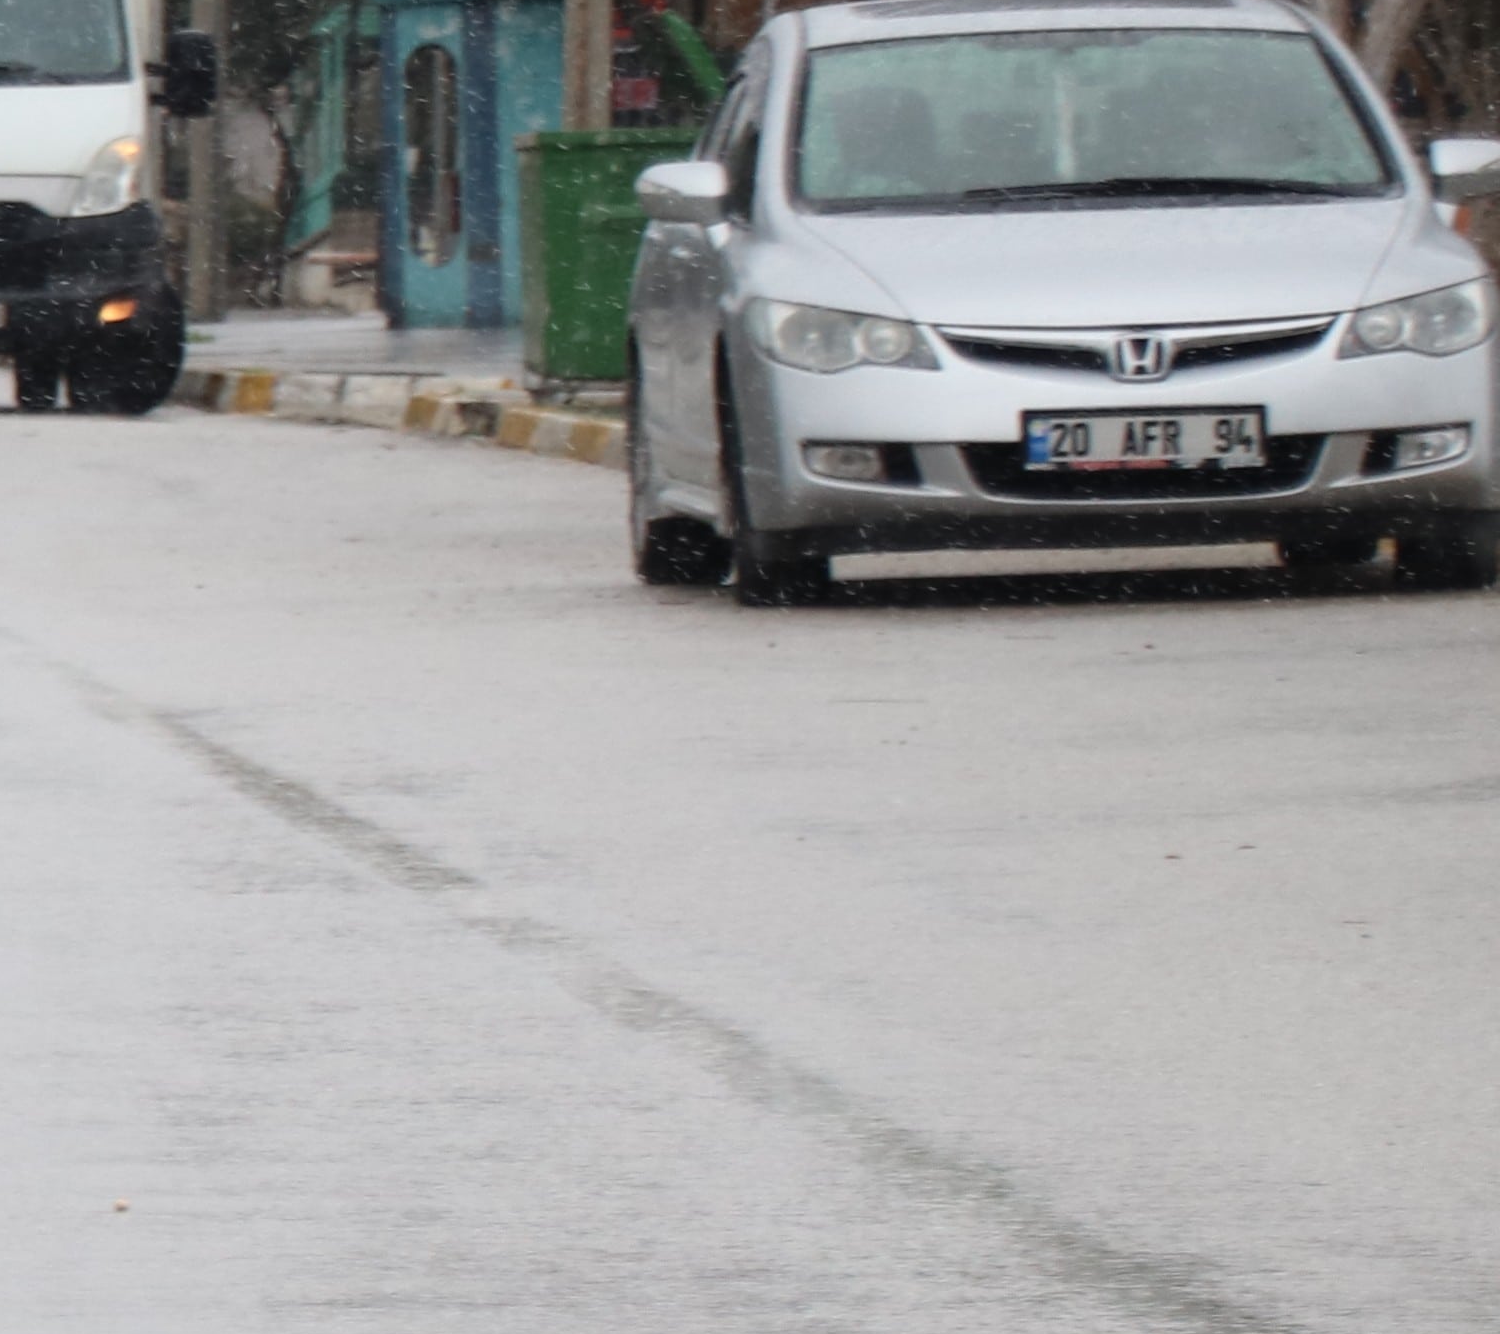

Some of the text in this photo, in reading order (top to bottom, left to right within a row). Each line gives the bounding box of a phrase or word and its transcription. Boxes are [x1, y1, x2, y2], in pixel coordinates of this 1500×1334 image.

[1052, 418, 1254, 457] 20 AFR 94
